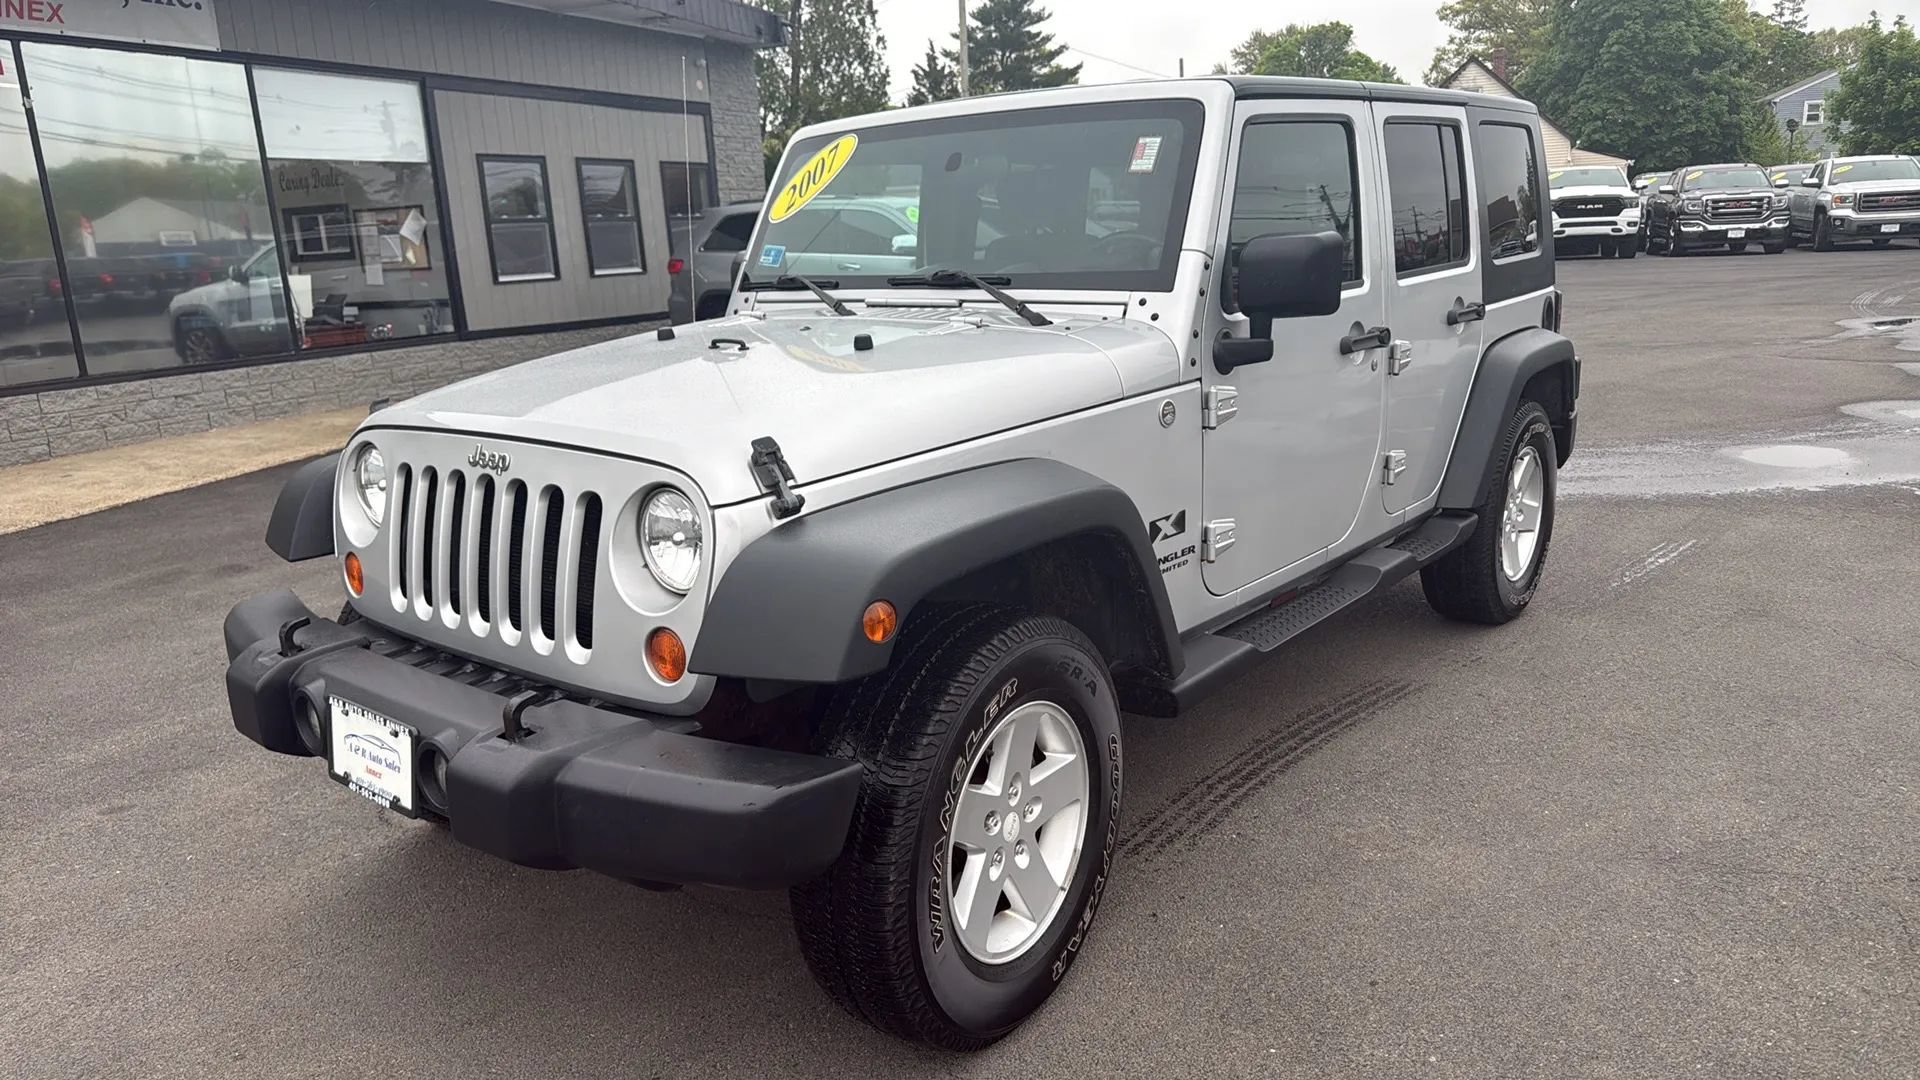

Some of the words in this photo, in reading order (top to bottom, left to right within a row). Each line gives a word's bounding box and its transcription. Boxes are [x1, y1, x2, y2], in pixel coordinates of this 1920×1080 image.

[0, 0, 64, 24] NEX
[785, 141, 841, 214] 2007
[1725, 200, 1752, 209] GMC
[468, 443, 511, 476] Jeep
[344, 702, 363, 715] AUTO
[364, 710, 384, 724] SALES
[386, 719, 410, 736] ANNEX
[368, 751, 382, 765] Auto
[384, 757, 401, 774] Sales
[930, 678, 1018, 952] WRANGLER
[1052, 733, 1123, 981] GOODYEAR
